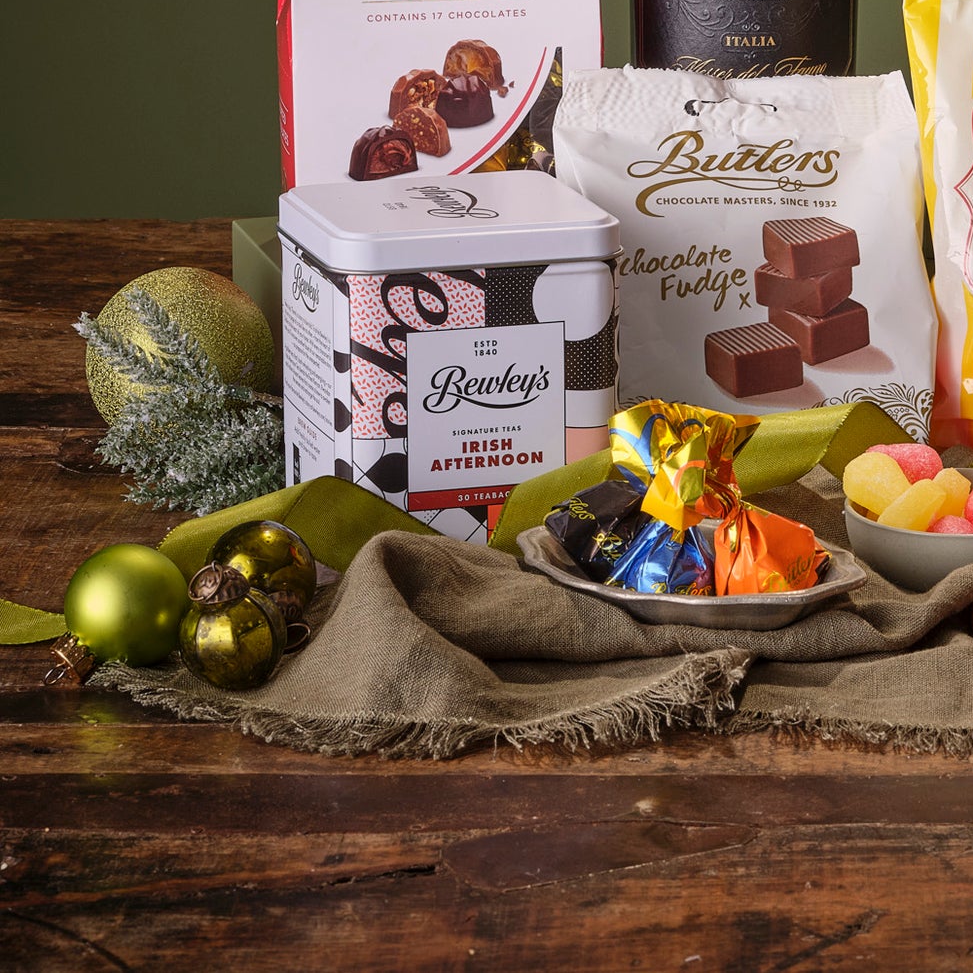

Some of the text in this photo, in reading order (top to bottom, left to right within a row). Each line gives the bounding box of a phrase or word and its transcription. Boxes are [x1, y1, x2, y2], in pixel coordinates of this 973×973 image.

[367, 9, 527, 23] CONTAINS 17 CHOCOLATES
[724, 36, 776, 47] ITALIA
[627, 130, 840, 191] Butlers
[655, 196, 837, 208] CHOCOLATE MASTERS, SINCE 1932
[620, 244, 732, 276] chocolate
[661, 268, 747, 312] Fudge
[474, 340, 498, 348] ESTD
[422, 362, 550, 413] Bewley's
[452, 426, 499, 436] SIGNATURE
[462, 438, 512, 453] IRISH
[430, 451, 544, 472] AFTERNOON
[457, 494, 470, 502] 30
